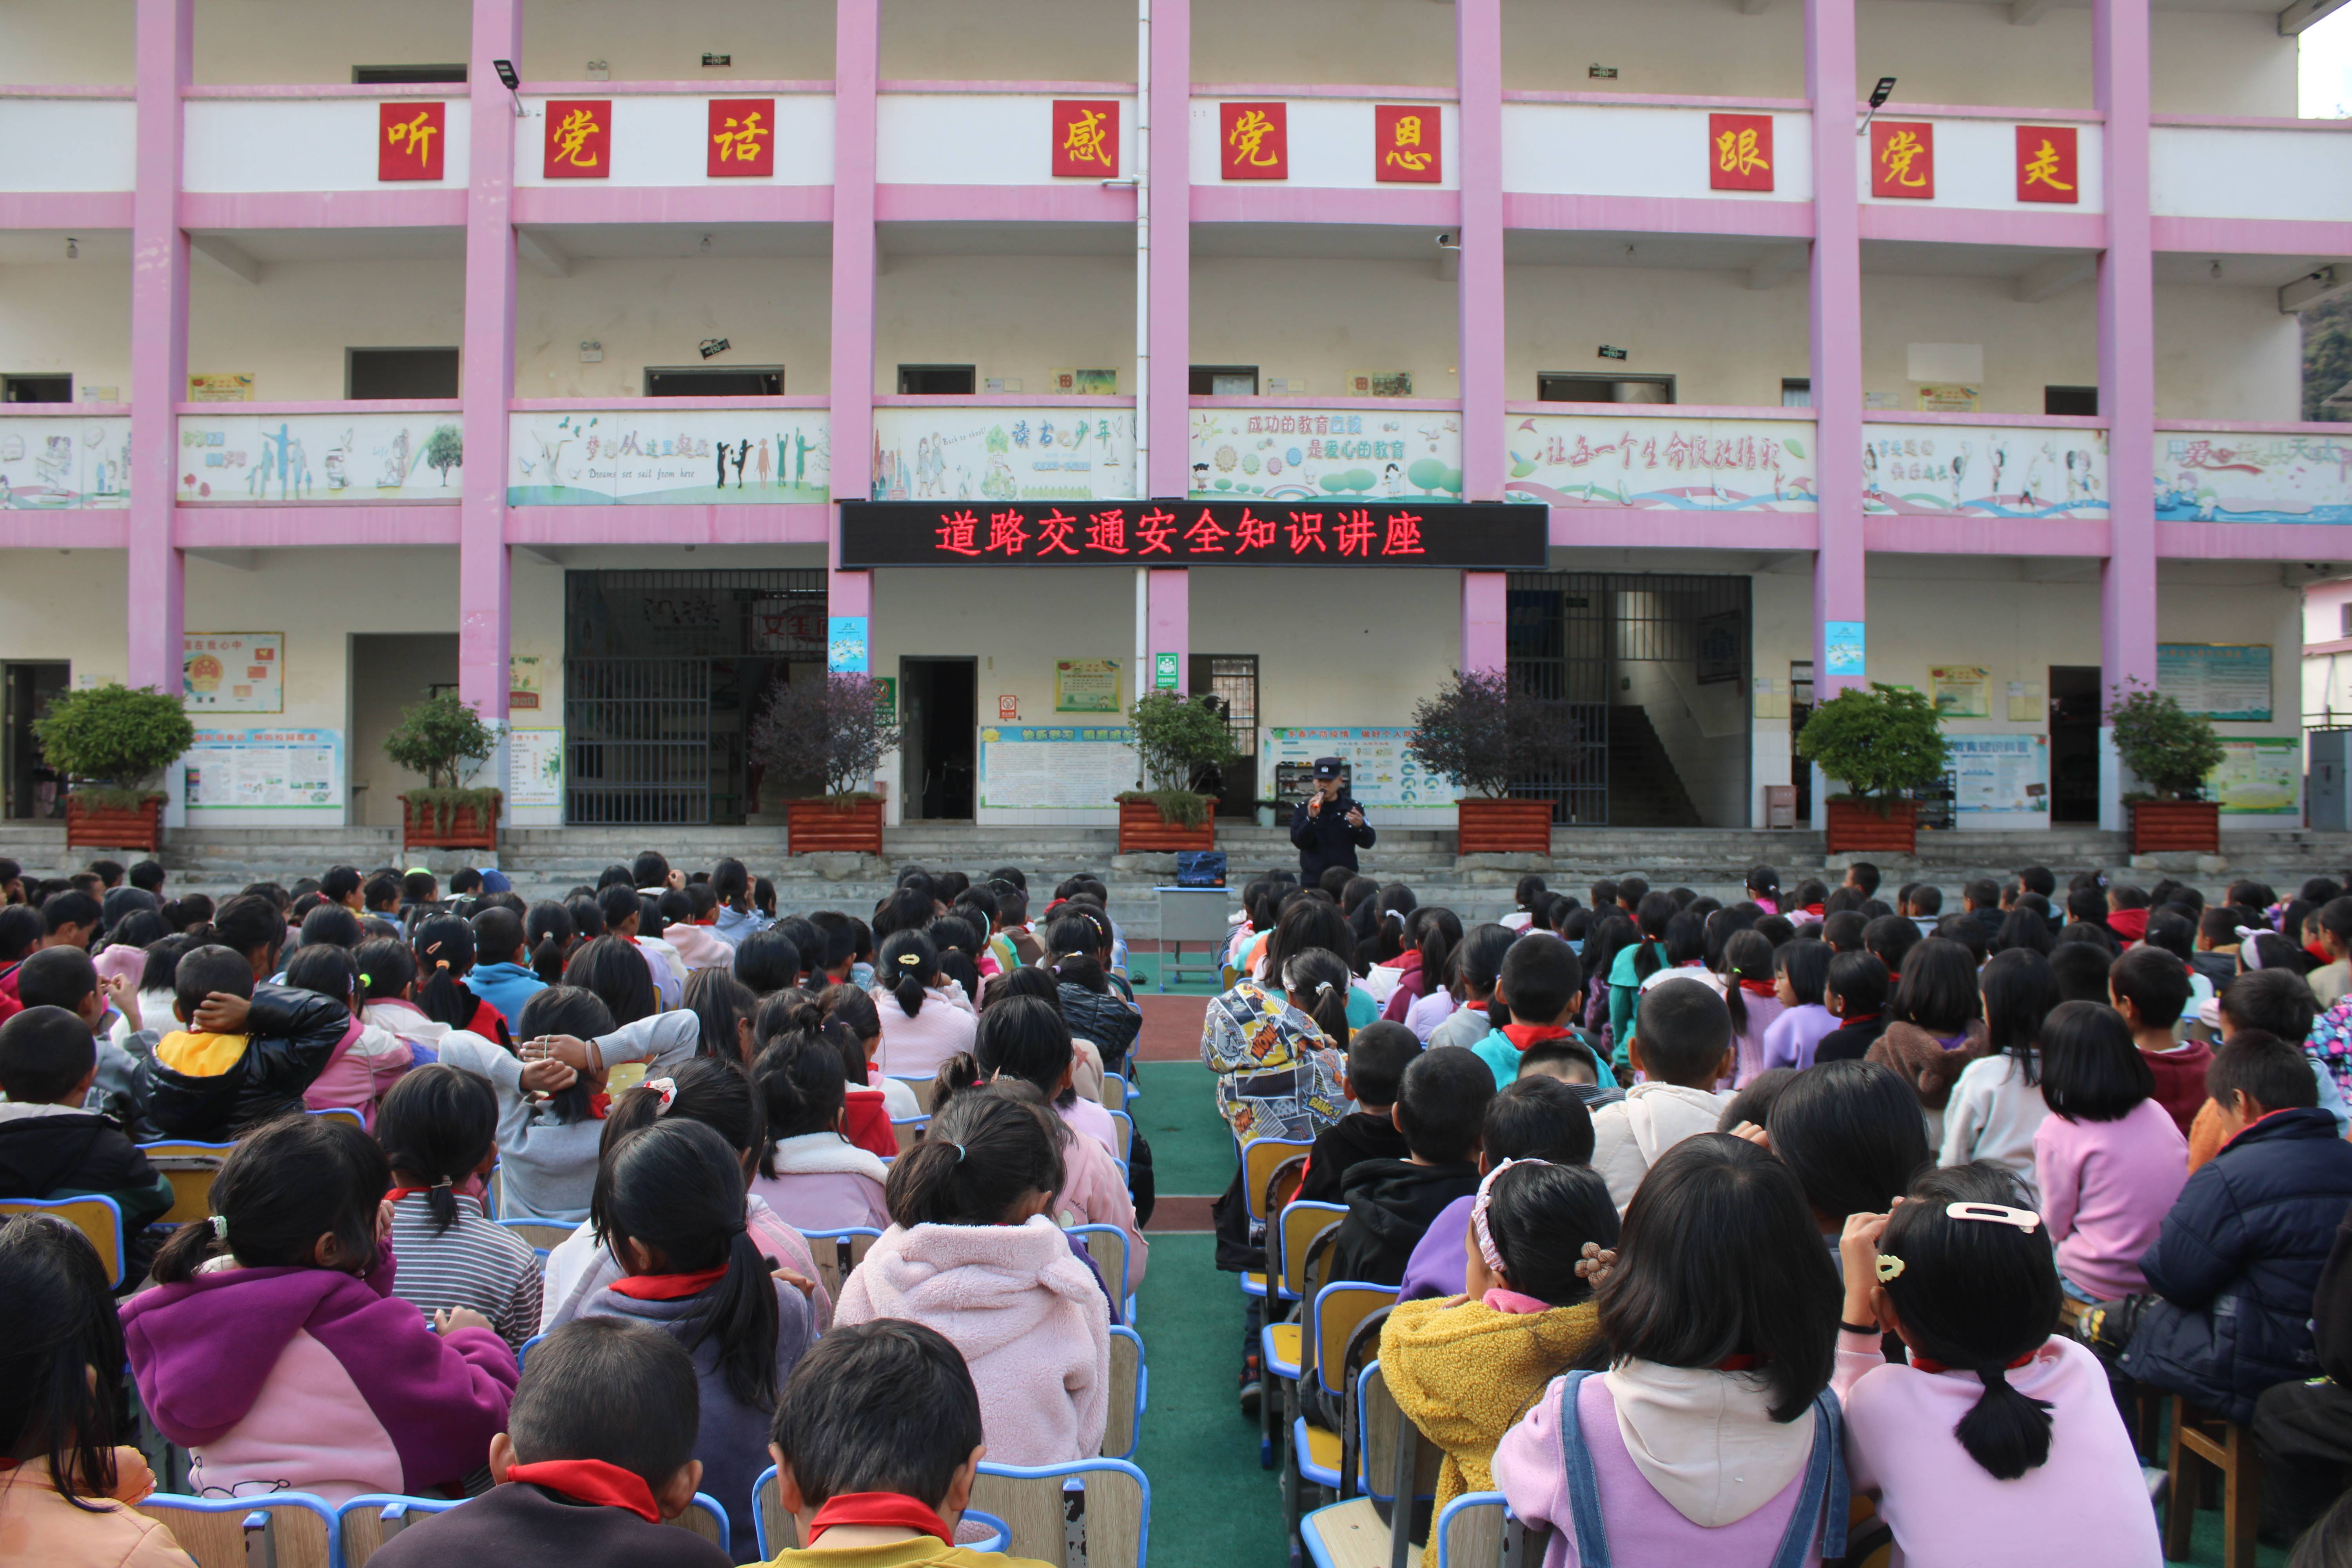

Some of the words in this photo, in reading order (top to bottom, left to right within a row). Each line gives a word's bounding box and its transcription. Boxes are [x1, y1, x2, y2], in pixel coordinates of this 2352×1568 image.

[1248, 415, 1363, 434] 成功的教育应该
[1308, 439, 1405, 460] 是爱心的教育
[1548, 430, 1780, 470] 让每一个生命绽放精彩
[588, 468, 616, 478] Dreams
[637, 469, 652, 478] sail
[657, 468, 675, 481] from
[680, 468, 695, 478] here
[935, 507, 1426, 557] 道路交通安全知识讲座
[1022, 729, 1074, 741] 快乐学习
[1288, 730, 1350, 738] 冬春严防疫情
[1251, 1022, 1279, 1058] WOW!
[1308, 1096, 1341, 1120] BANG!
